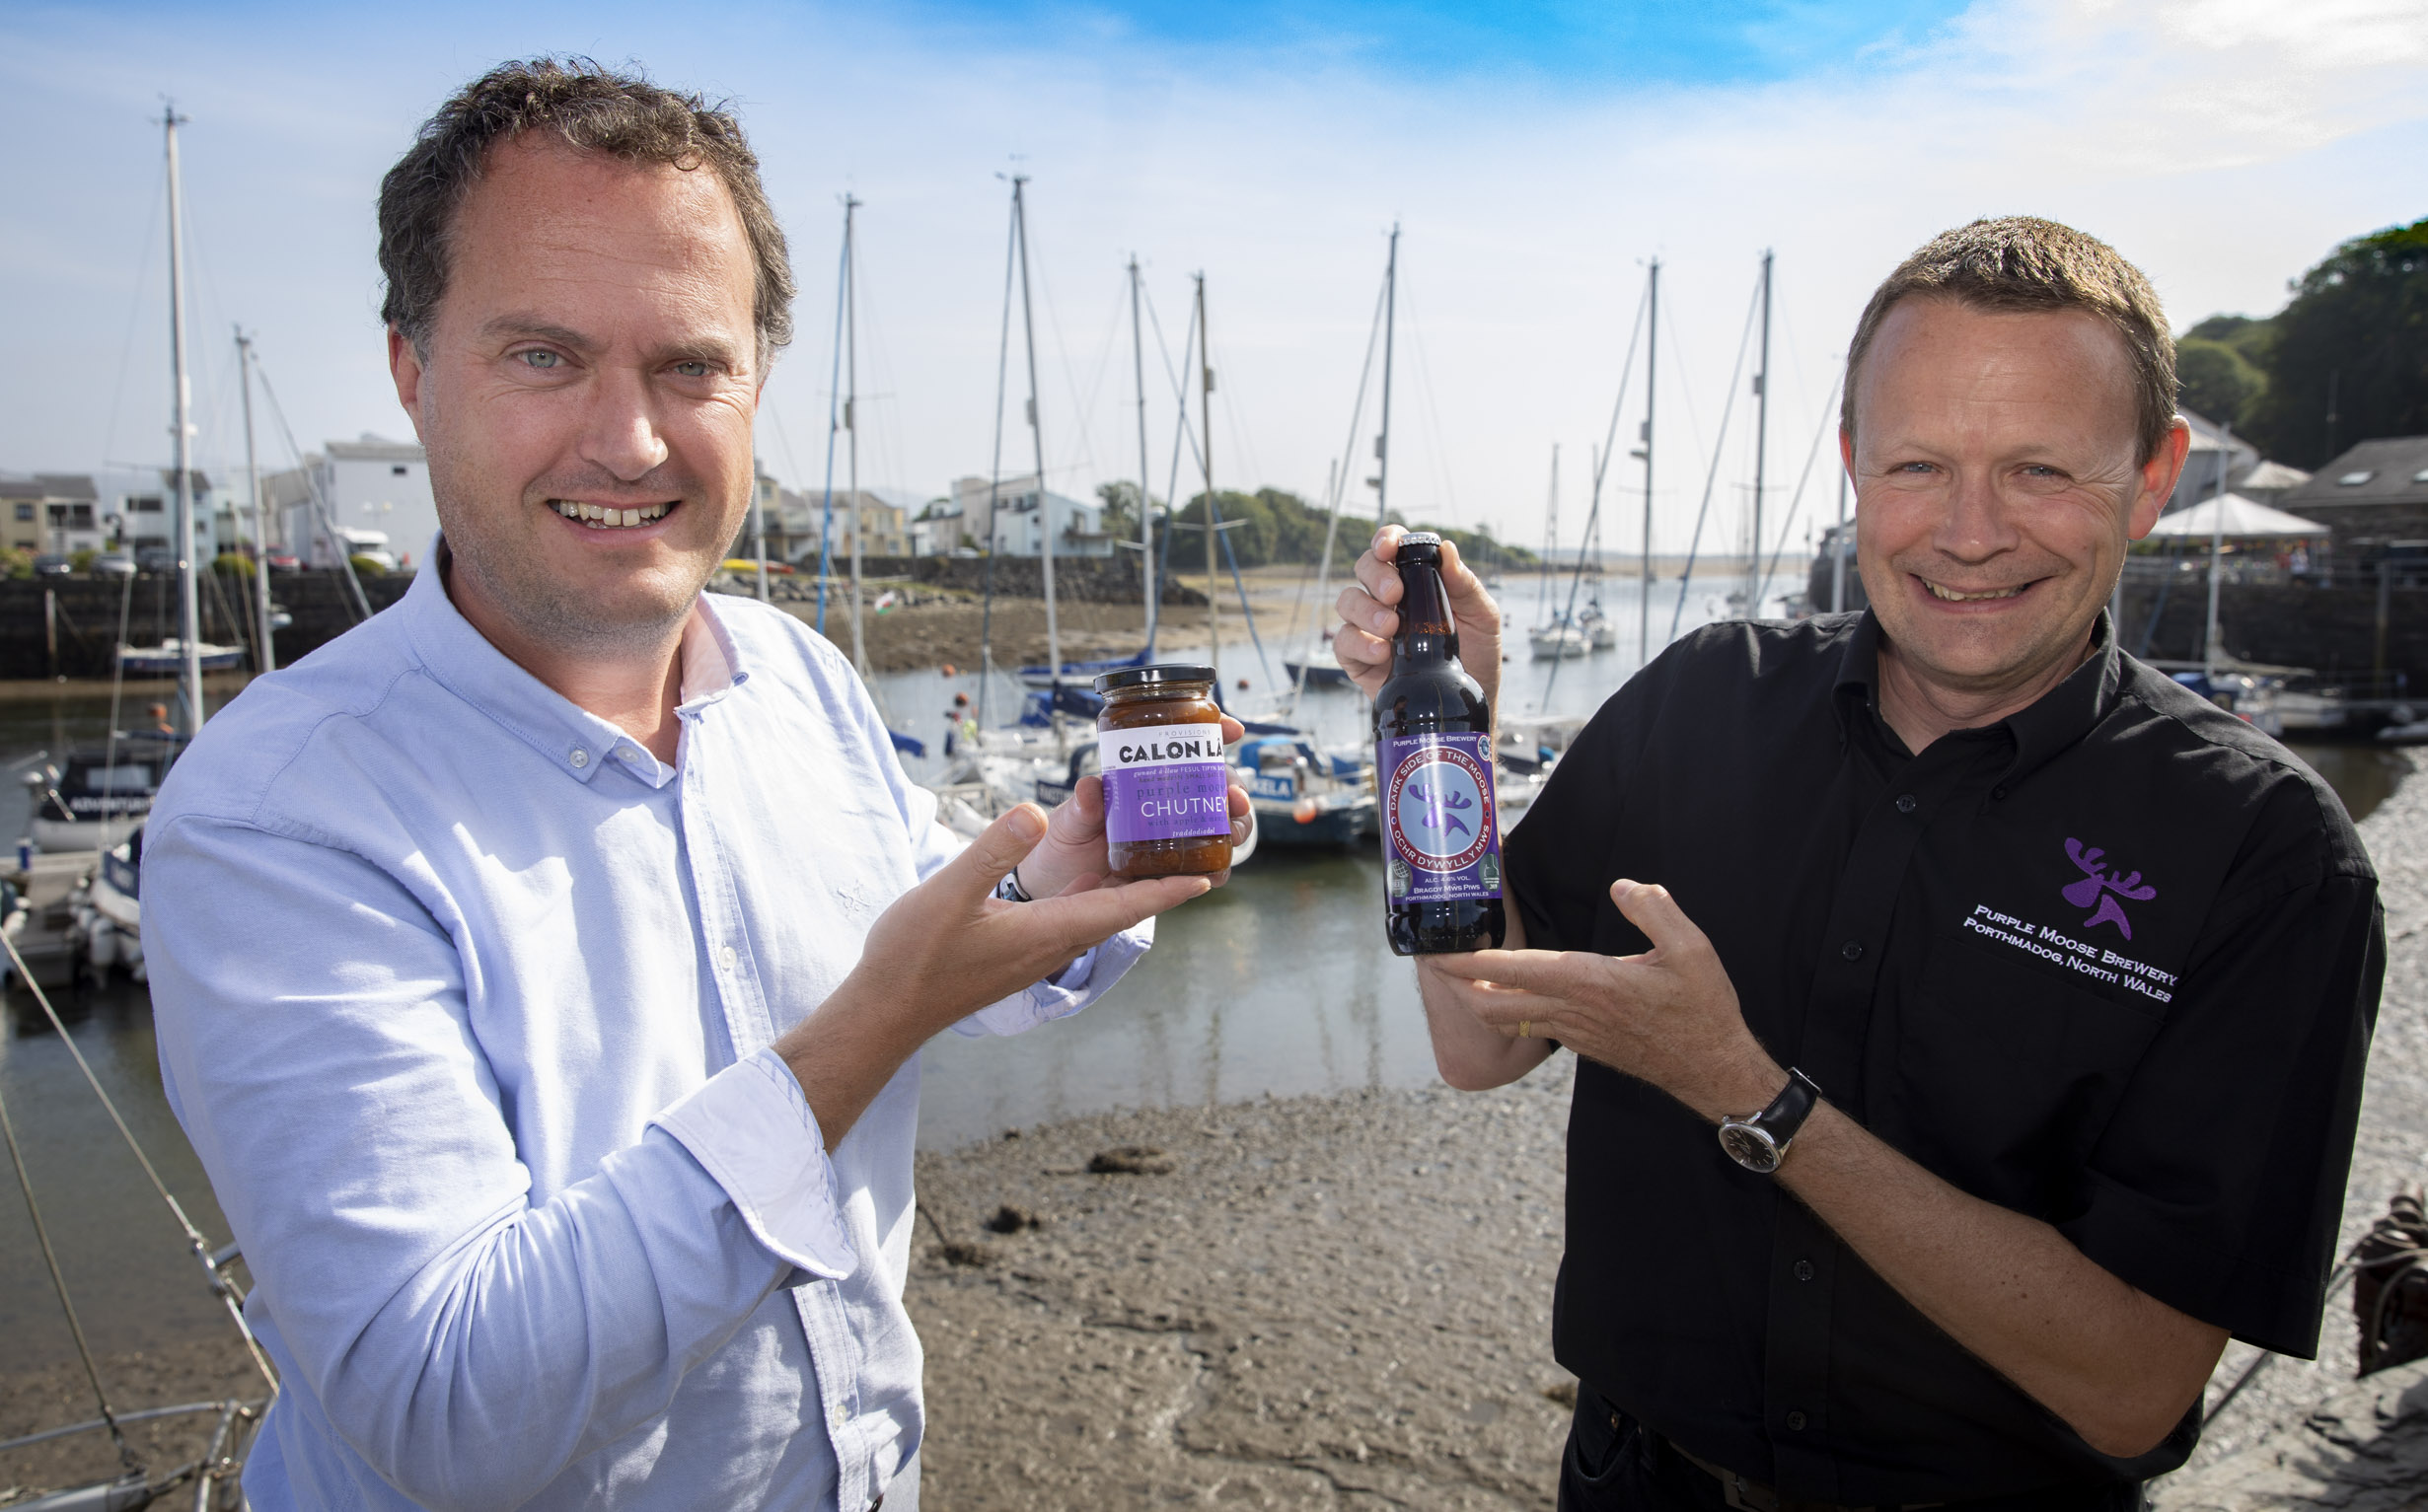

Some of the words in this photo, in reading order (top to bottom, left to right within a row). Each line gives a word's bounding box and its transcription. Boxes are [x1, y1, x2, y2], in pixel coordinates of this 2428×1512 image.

[1119, 741, 1201, 763] CALON
[1393, 739, 1418, 748] PURPLE
[1137, 781, 1190, 800] purple
[1390, 777, 1403, 811] DARK
[1400, 755, 1424, 776] SIDE
[1426, 751, 1442, 760] OF
[1445, 751, 1468, 765] THE
[1468, 763, 1490, 804] MOOSE
[1140, 796, 1227, 818] CHUTNEY
[1394, 829, 1417, 860] OCHR
[1417, 855, 1468, 869] DYWYLL
[1468, 851, 1475, 860] Y
[1963, 916, 2064, 966] PORTHMADOG,
[2066, 955, 2118, 984] NORTH
[2122, 973, 2172, 1003] WALES
[1973, 904, 2036, 935] PURPLE
[2038, 925, 2098, 959] MOOSE
[2100, 949, 2178, 987] BREWERY
